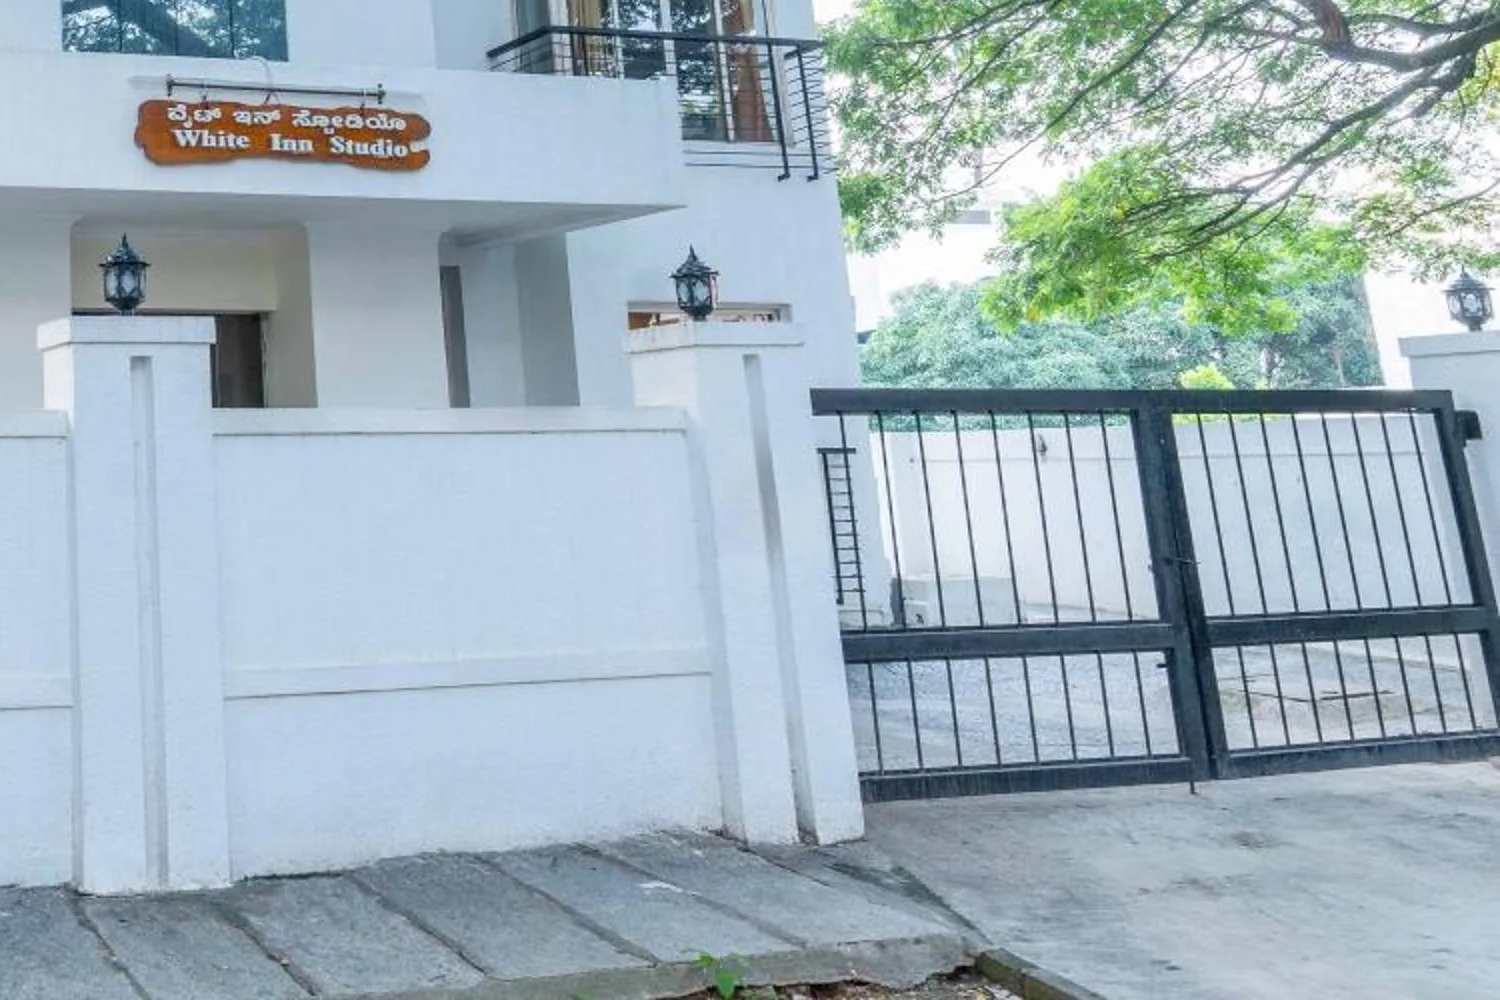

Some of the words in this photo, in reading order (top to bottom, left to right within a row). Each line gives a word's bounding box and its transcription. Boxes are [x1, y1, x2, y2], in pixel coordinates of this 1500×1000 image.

[171, 129, 252, 150] White
[269, 133, 316, 154] Inn
[328, 135, 409, 158] Studio
